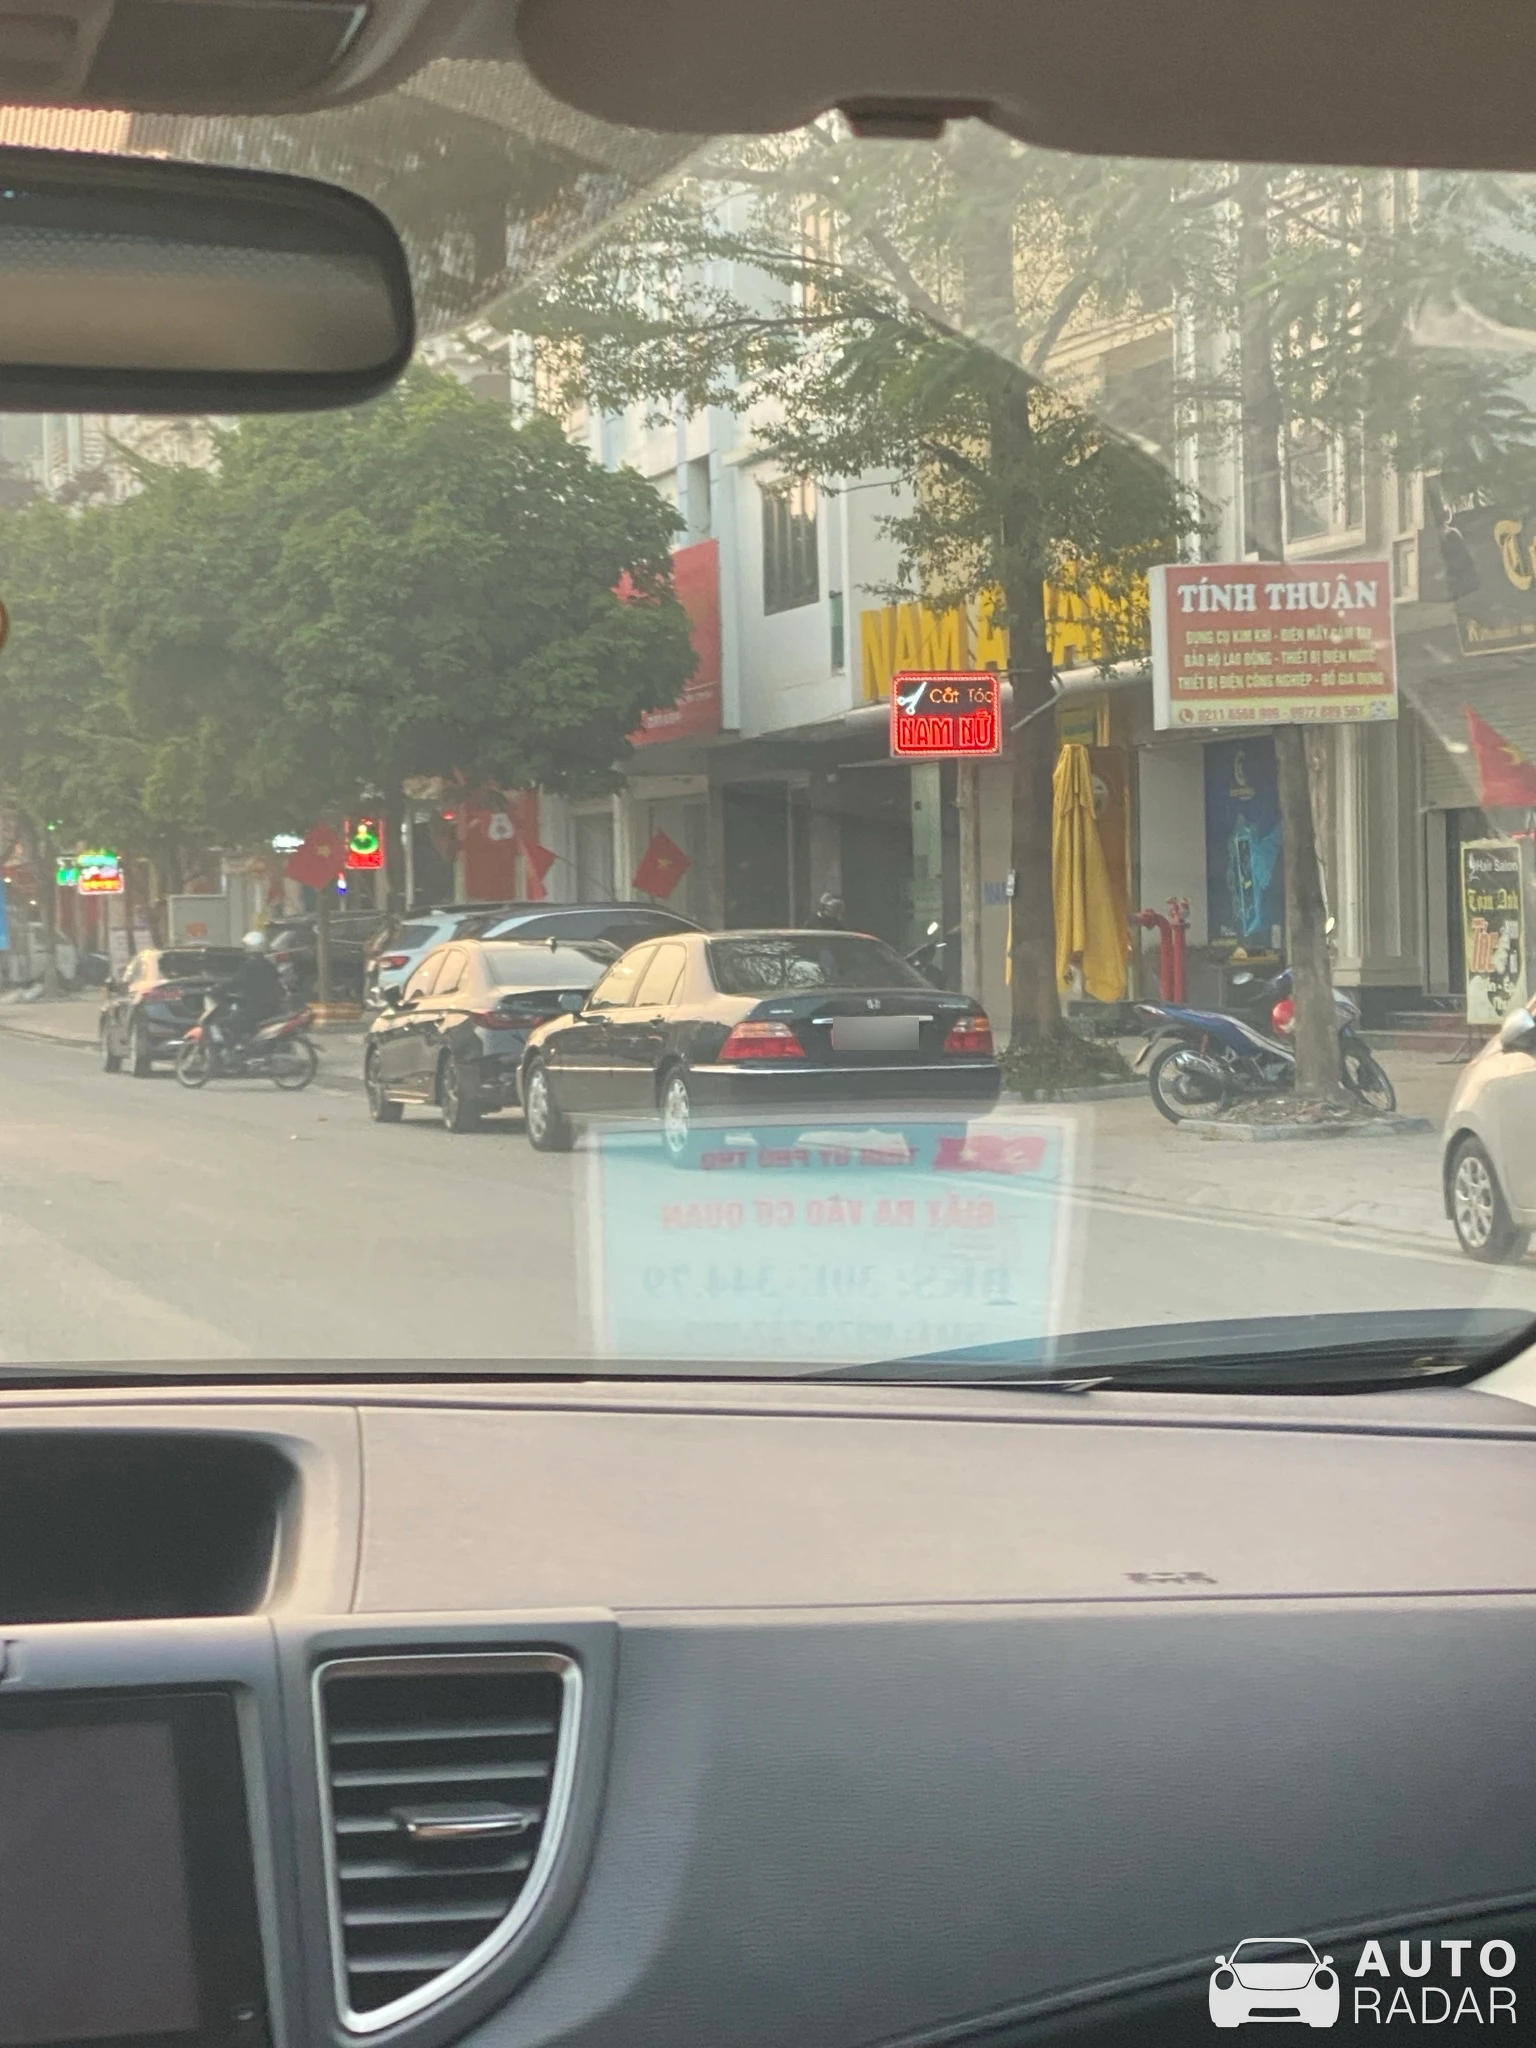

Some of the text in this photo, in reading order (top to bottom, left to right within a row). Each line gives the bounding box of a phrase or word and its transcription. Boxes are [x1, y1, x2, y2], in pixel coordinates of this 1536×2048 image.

[1177, 573, 1377, 618] TÍNH THUẬN
[862, 602, 961, 700] NAM
[930, 686, 959, 704] Cắt
[900, 709, 992, 748] NAM NỮ
